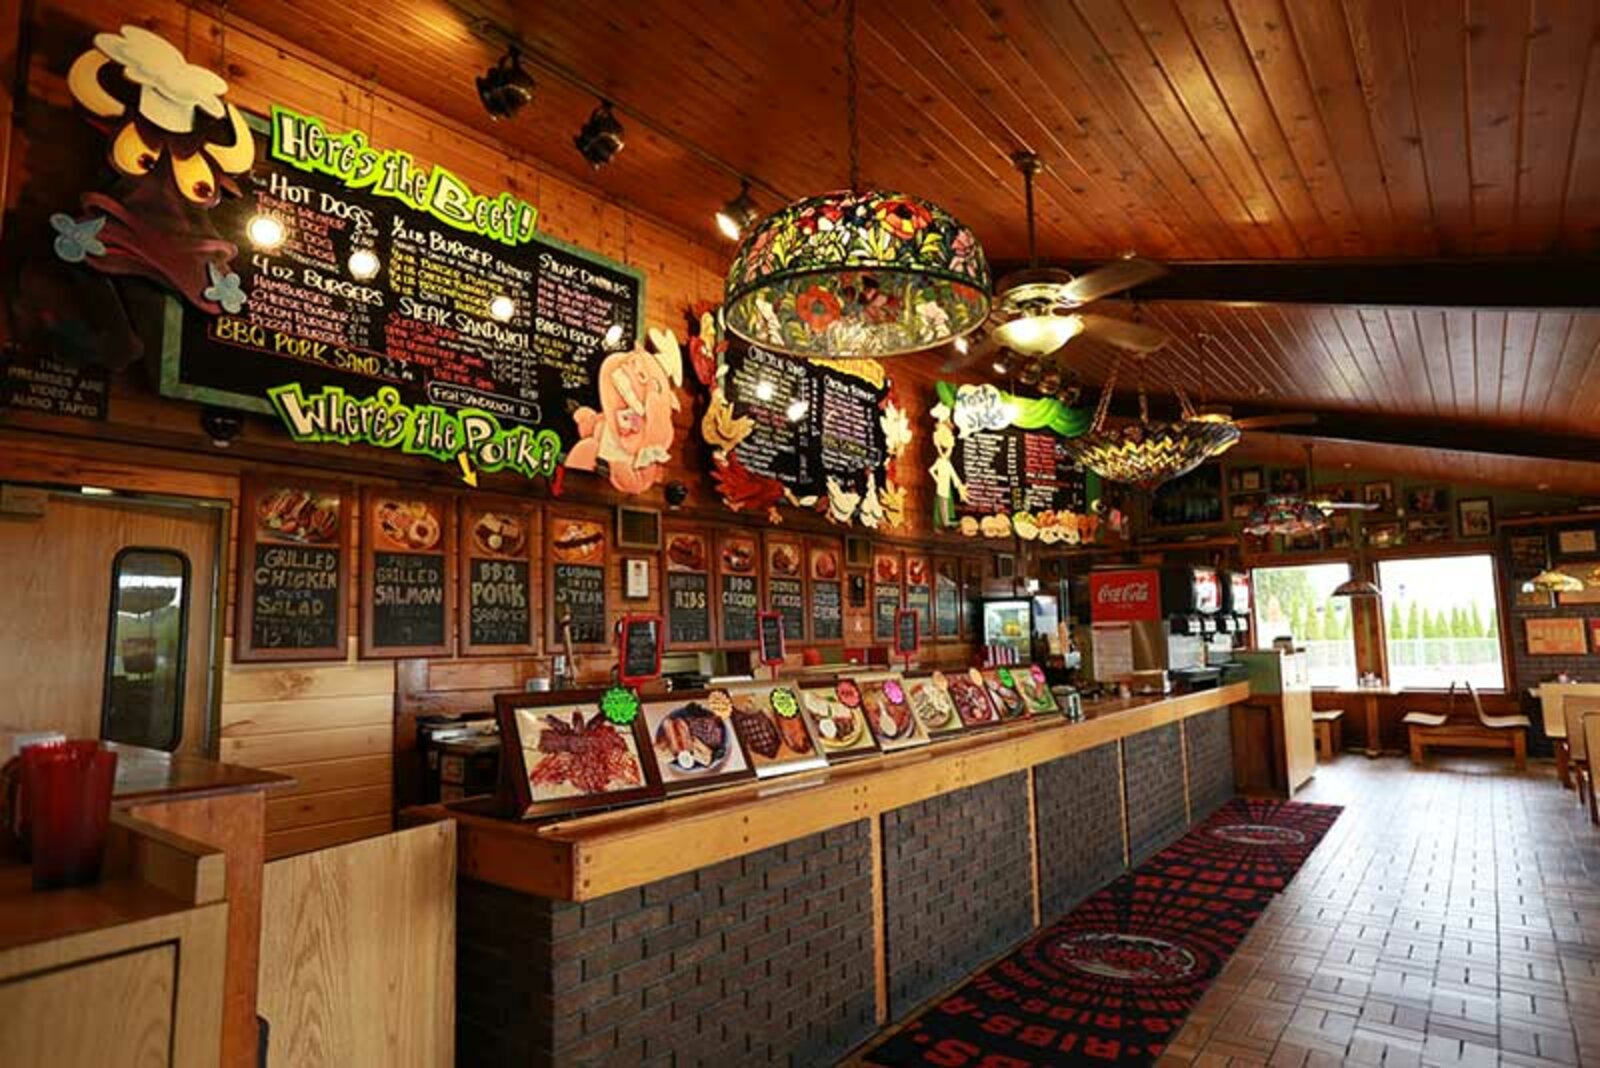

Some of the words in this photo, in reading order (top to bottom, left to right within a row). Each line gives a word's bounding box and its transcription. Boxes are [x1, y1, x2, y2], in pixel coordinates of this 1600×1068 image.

[280, 113, 377, 180] Here's
[382, 154, 429, 208] the
[433, 170, 534, 239] Beef!
[429, 230, 493, 267] BURGER
[252, 254, 269, 275] 4
[303, 269, 385, 307] BURGERS
[400, 296, 453, 327] STEAK
[216, 316, 266, 347] BBQ
[275, 332, 329, 364] PORK
[280, 391, 407, 440] Where's
[414, 410, 456, 450] the
[464, 414, 554, 471] Pork?
[264, 549, 336, 571] GRILLED
[480, 562, 516, 582] BBQ
[255, 568, 337, 590] CHICKEN
[376, 567, 438, 583] GRILLED
[256, 595, 324, 617] SALAD
[375, 584, 442, 605] SALMON
[472, 581, 526, 607] PORK
[675, 590, 706, 609] RIBS
